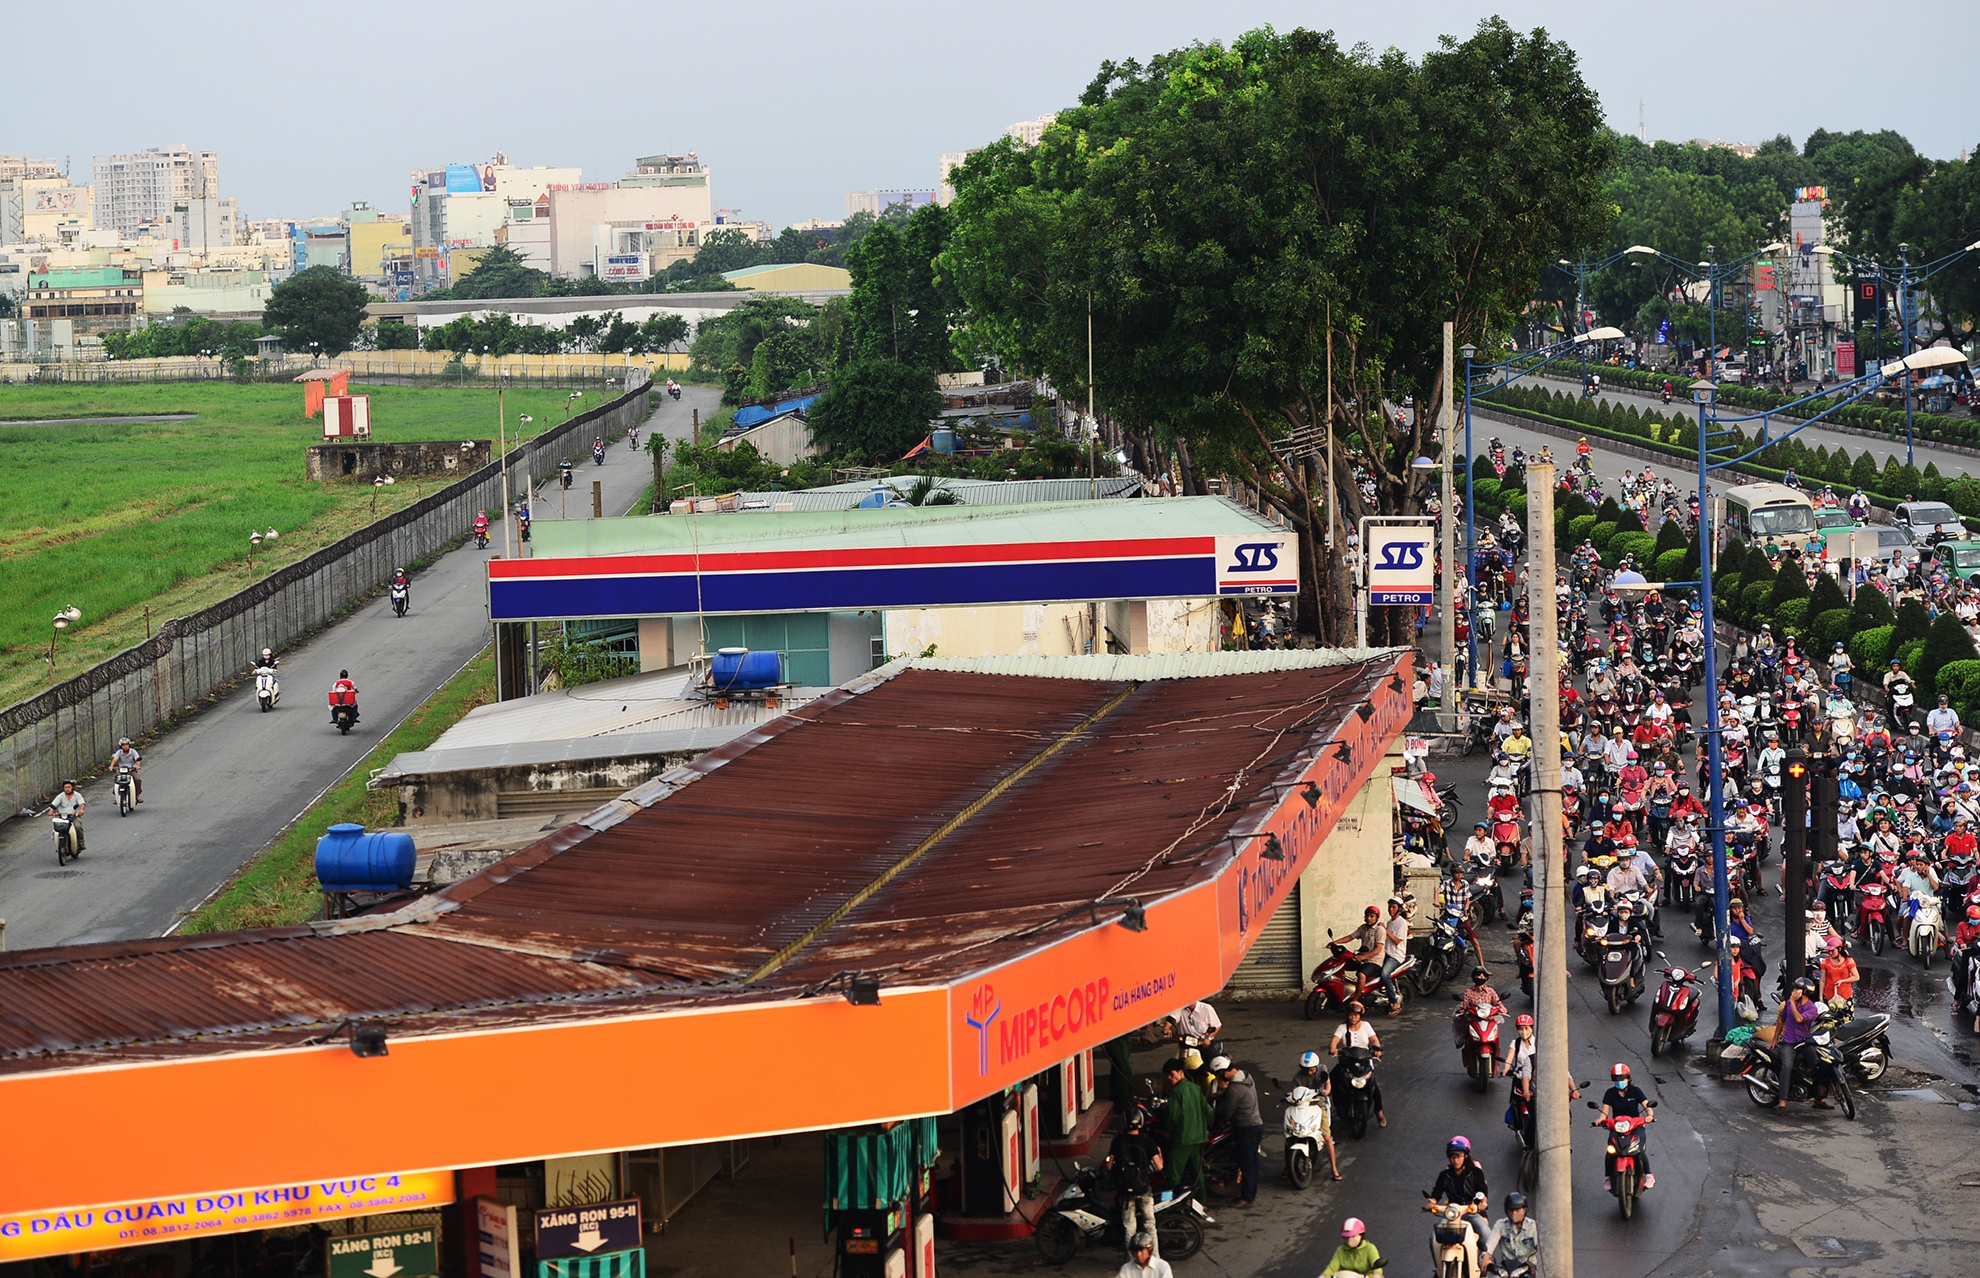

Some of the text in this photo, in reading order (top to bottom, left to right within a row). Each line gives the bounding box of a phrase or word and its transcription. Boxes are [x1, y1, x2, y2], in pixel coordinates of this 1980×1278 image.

[1227, 542, 1285, 573] STS
[1374, 541, 1430, 570] STS
[1382, 594, 1421, 602] PETRO
[1000, 976, 1110, 1066] MIPECORP
[1131, 981, 1152, 1004] HÀNG
[1153, 977, 1167, 997] ĐẠI
[1167, 968, 1177, 989] LÝ
[103, 1201, 186, 1225] QUÂN
[195, 1192, 244, 1214] ĐỘI
[254, 1186, 311, 1206] KHU
[386, 1175, 401, 1187] 4
[540, 1213, 577, 1229] XĂNG
[579, 1208, 607, 1223] RON
[578, 1222, 599, 1233] (KC)
[332, 1238, 371, 1255] XĂNG
[372, 1235, 402, 1250] RON
[372, 1249, 394, 1260] (KC)
